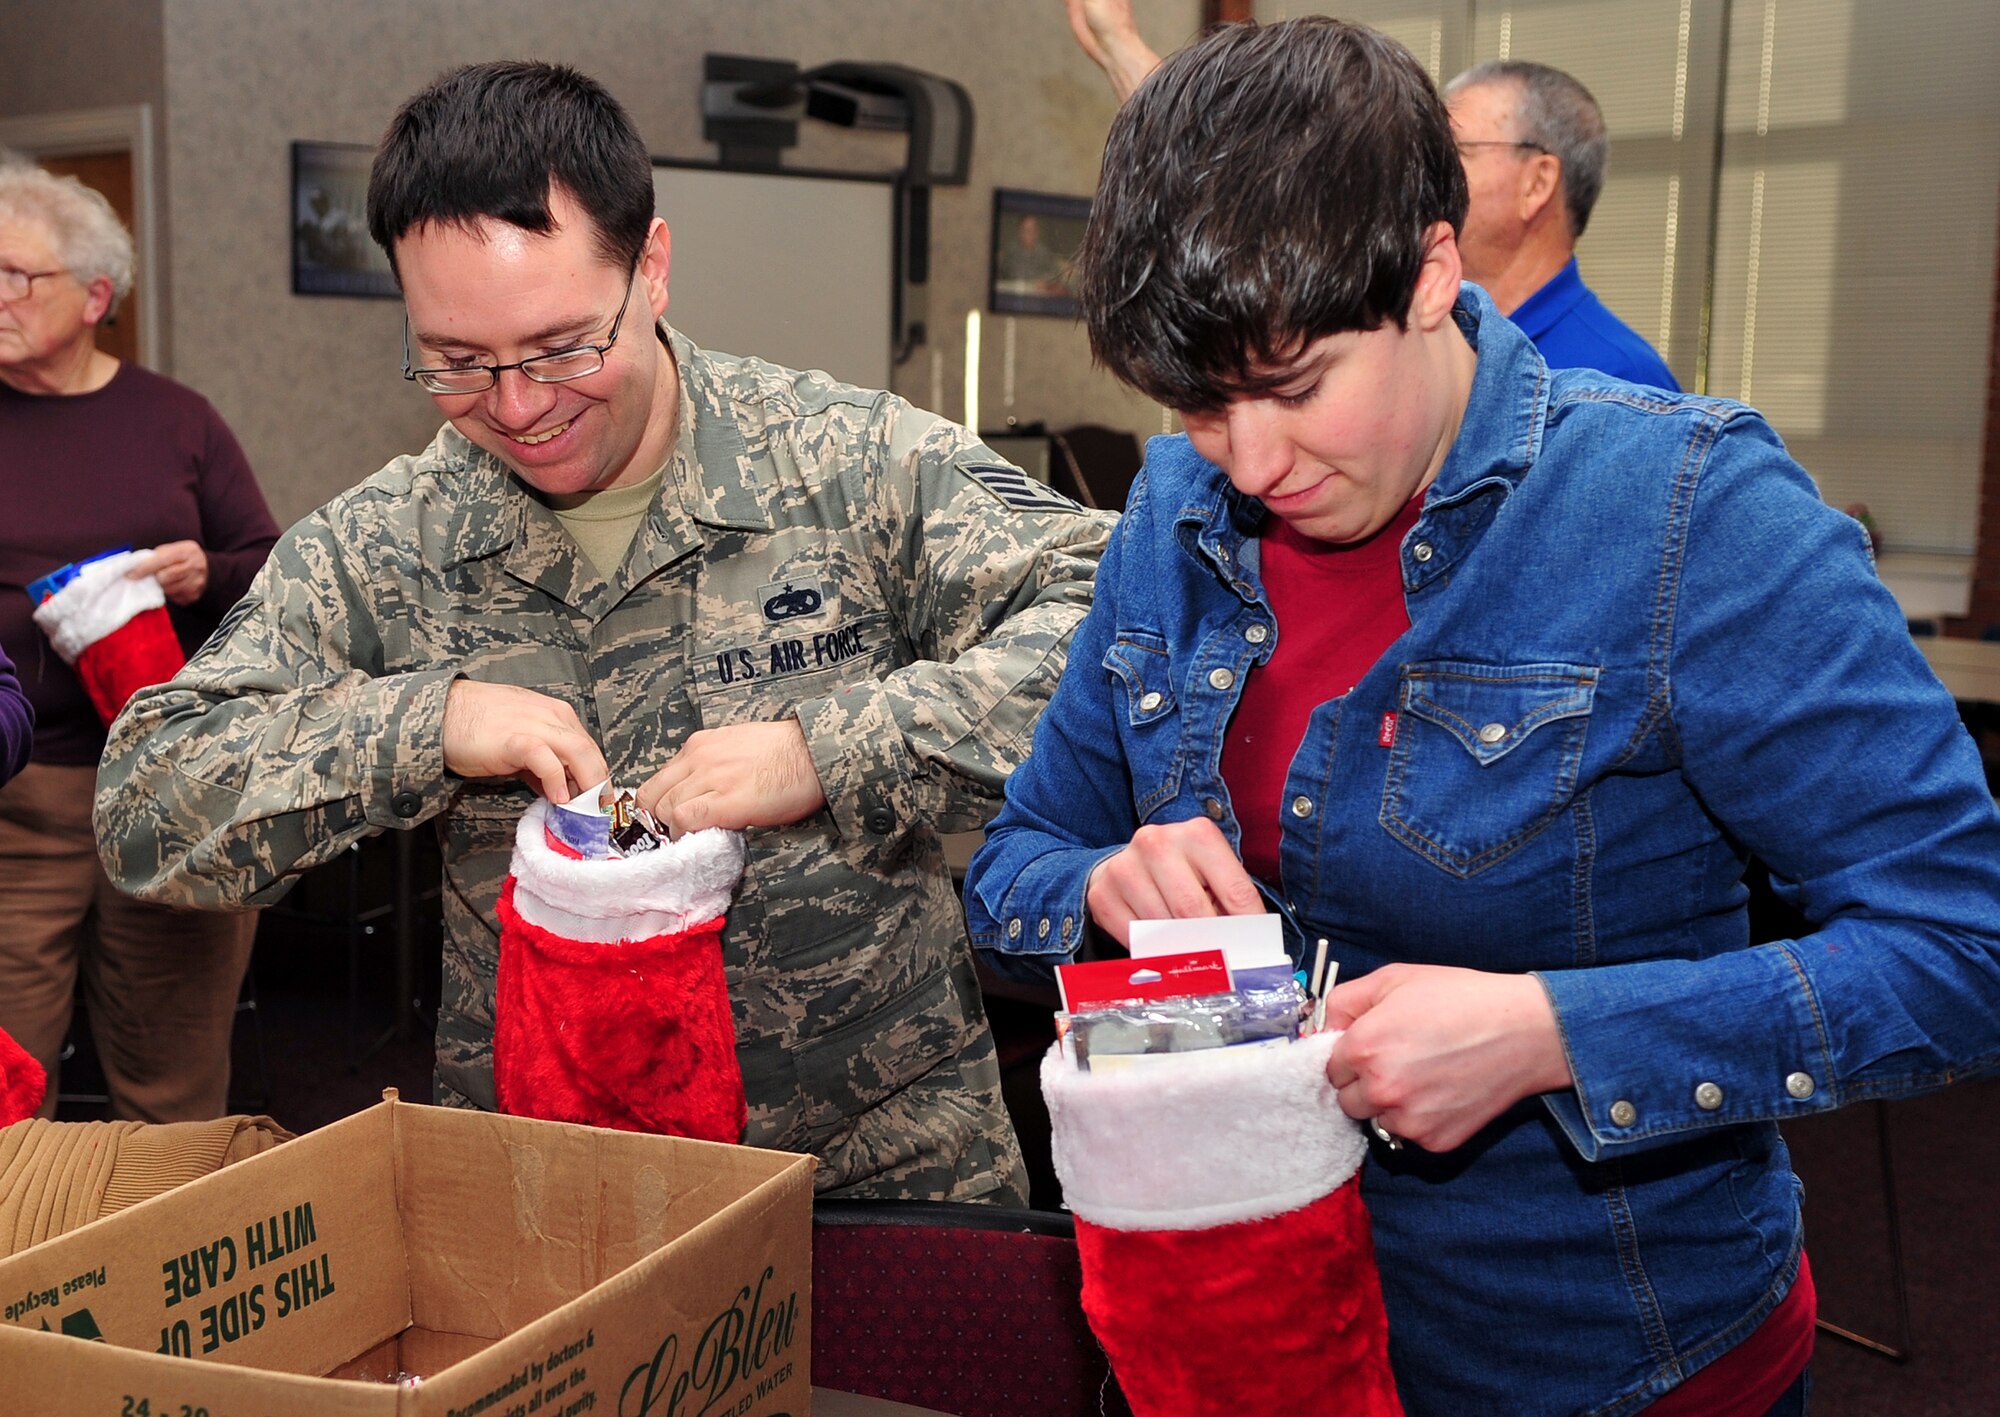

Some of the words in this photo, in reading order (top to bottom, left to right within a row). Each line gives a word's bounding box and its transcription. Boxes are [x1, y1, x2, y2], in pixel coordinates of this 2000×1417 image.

[716, 649, 761, 684] U.S.
[770, 639, 807, 674] AIR
[813, 622, 868, 666] FORCE
[624, 833, 657, 857] Too
[245, 1201, 317, 1271] WITH
[63, 1265, 107, 1296] Please
[162, 1236, 237, 1309] CARE
[274, 1253, 335, 1318] THIS
[5, 1287, 60, 1322] Recycle
[200, 1284, 266, 1354] SIDE
[531, 1361, 544, 1383] by
[547, 1337, 585, 1371] doctors
[121, 1395, 150, 1417] 24
[528, 1389, 542, 1414] all
[545, 1379, 567, 1403] over
[569, 1367, 586, 1388] the
[719, 1392, 753, 1417] TLED
[756, 1362, 793, 1401] WATER
